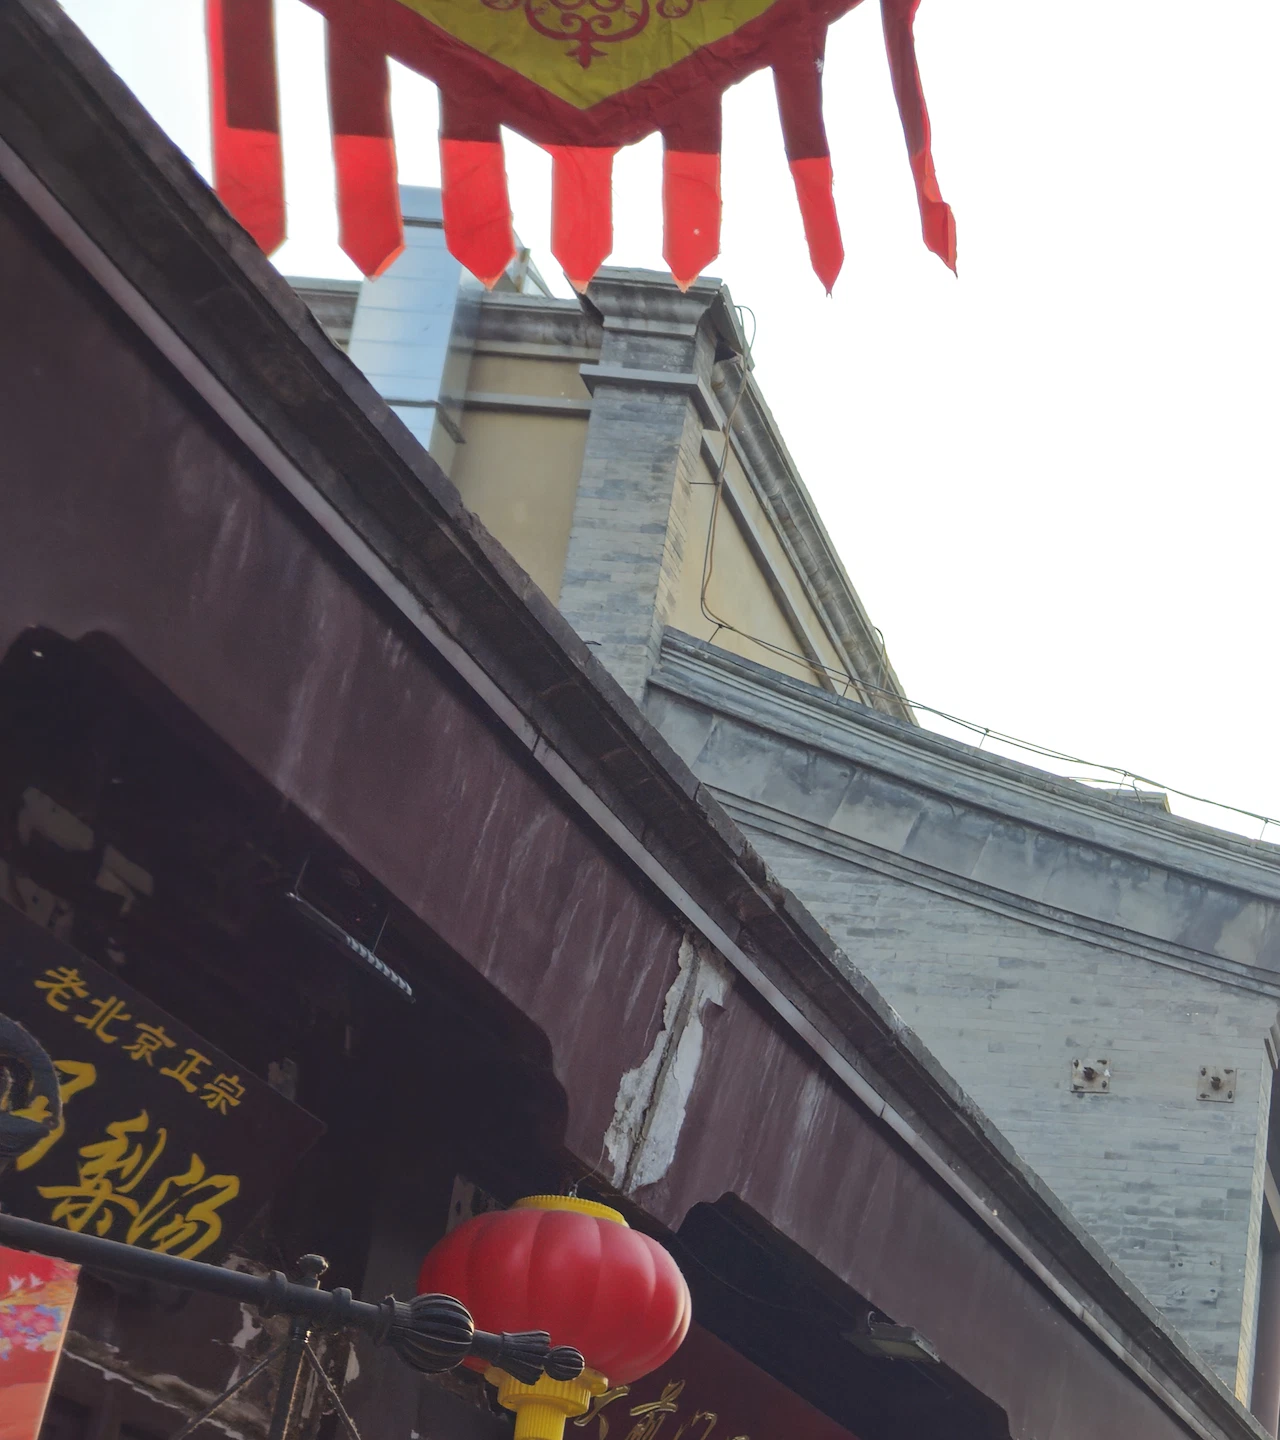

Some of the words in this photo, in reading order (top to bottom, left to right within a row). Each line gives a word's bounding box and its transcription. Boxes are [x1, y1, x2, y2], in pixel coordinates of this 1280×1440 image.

[34, 965, 247, 1116] 老北京正宗
